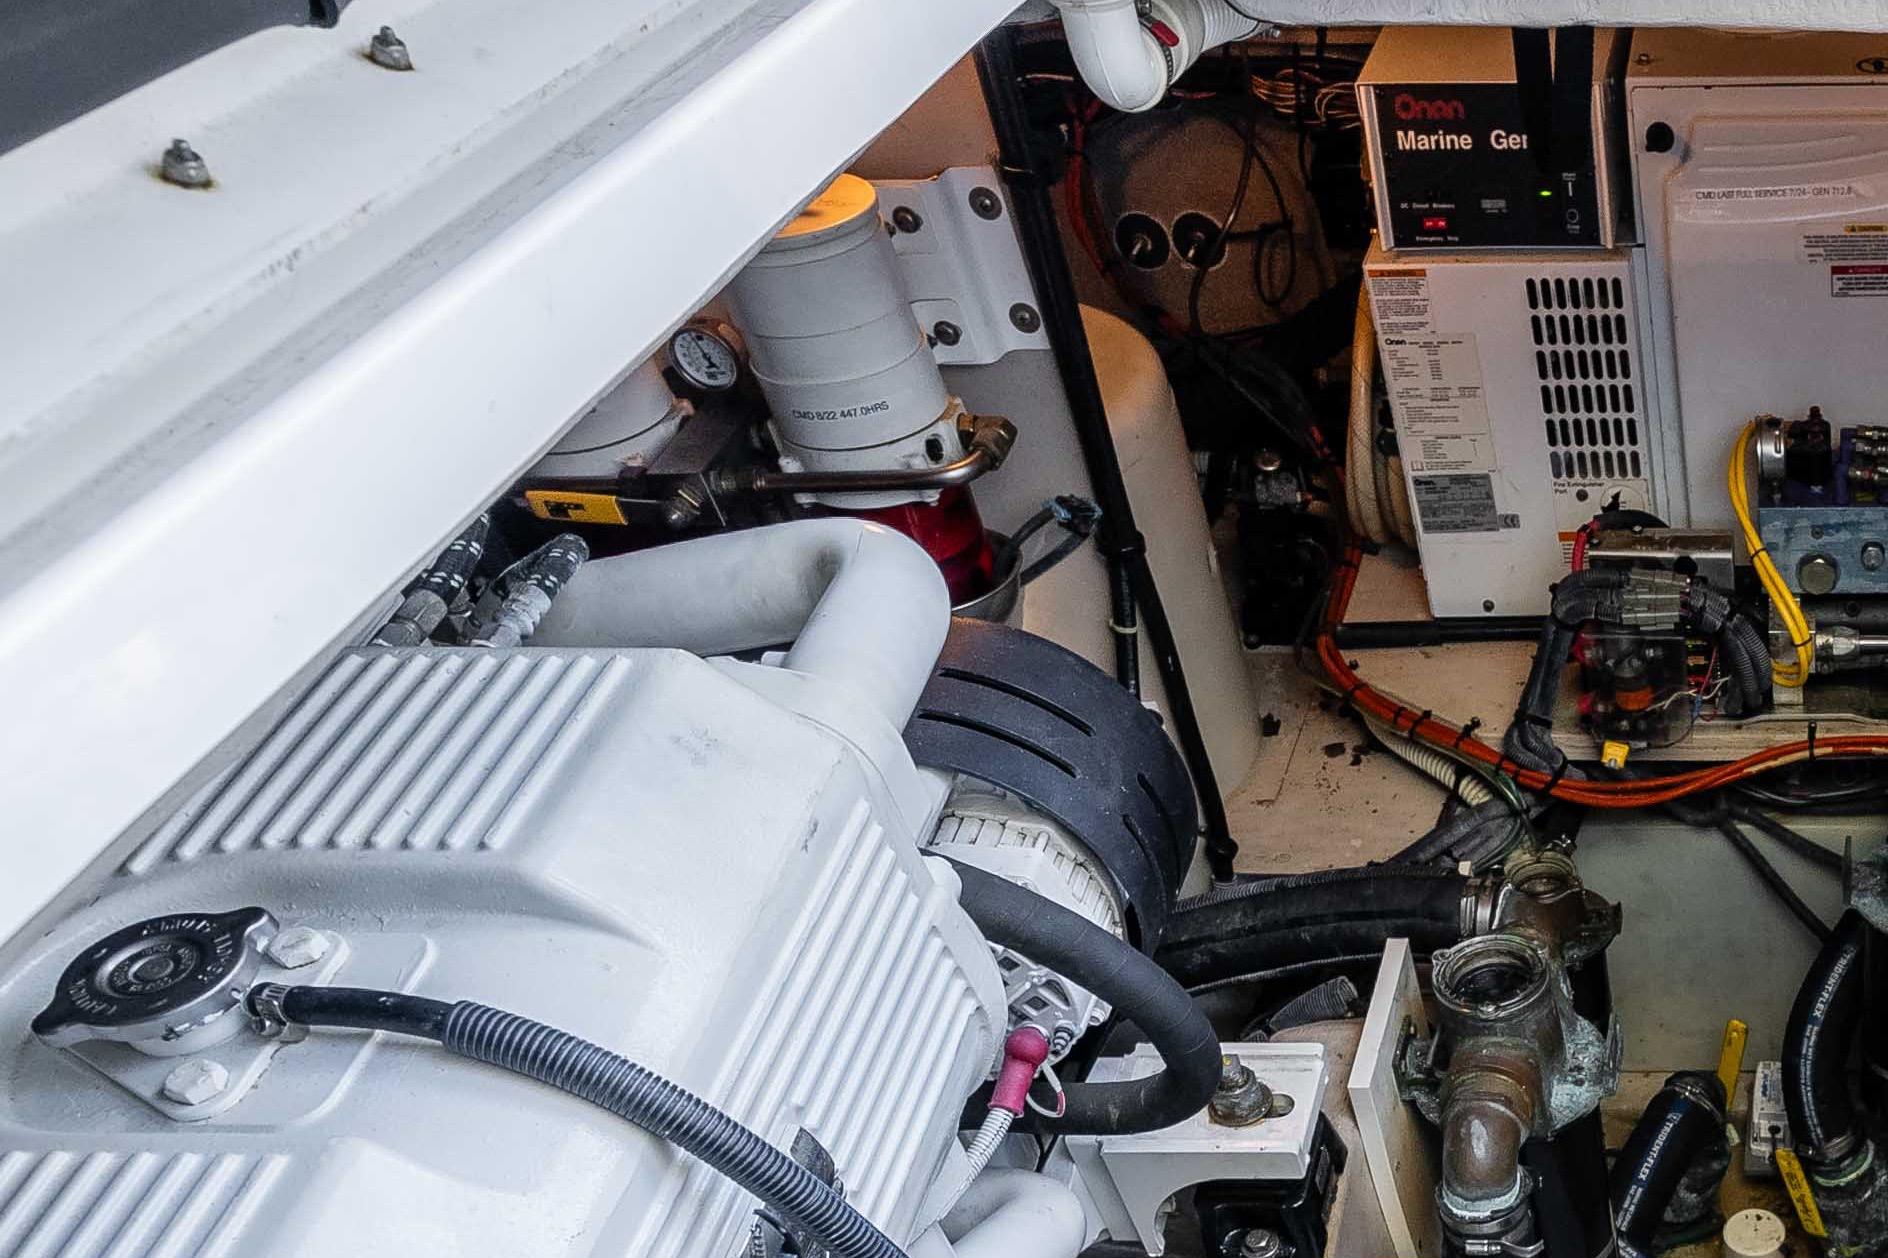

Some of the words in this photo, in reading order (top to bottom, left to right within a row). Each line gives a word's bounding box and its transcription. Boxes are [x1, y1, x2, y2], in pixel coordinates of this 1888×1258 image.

[1394, 93, 1465, 120] Onan
[1396, 129, 1472, 150] Marine
[1812, 952, 1851, 1019] TRIDENT-FLEX
[1636, 1120, 1674, 1181] TRIDENT-FLEX
